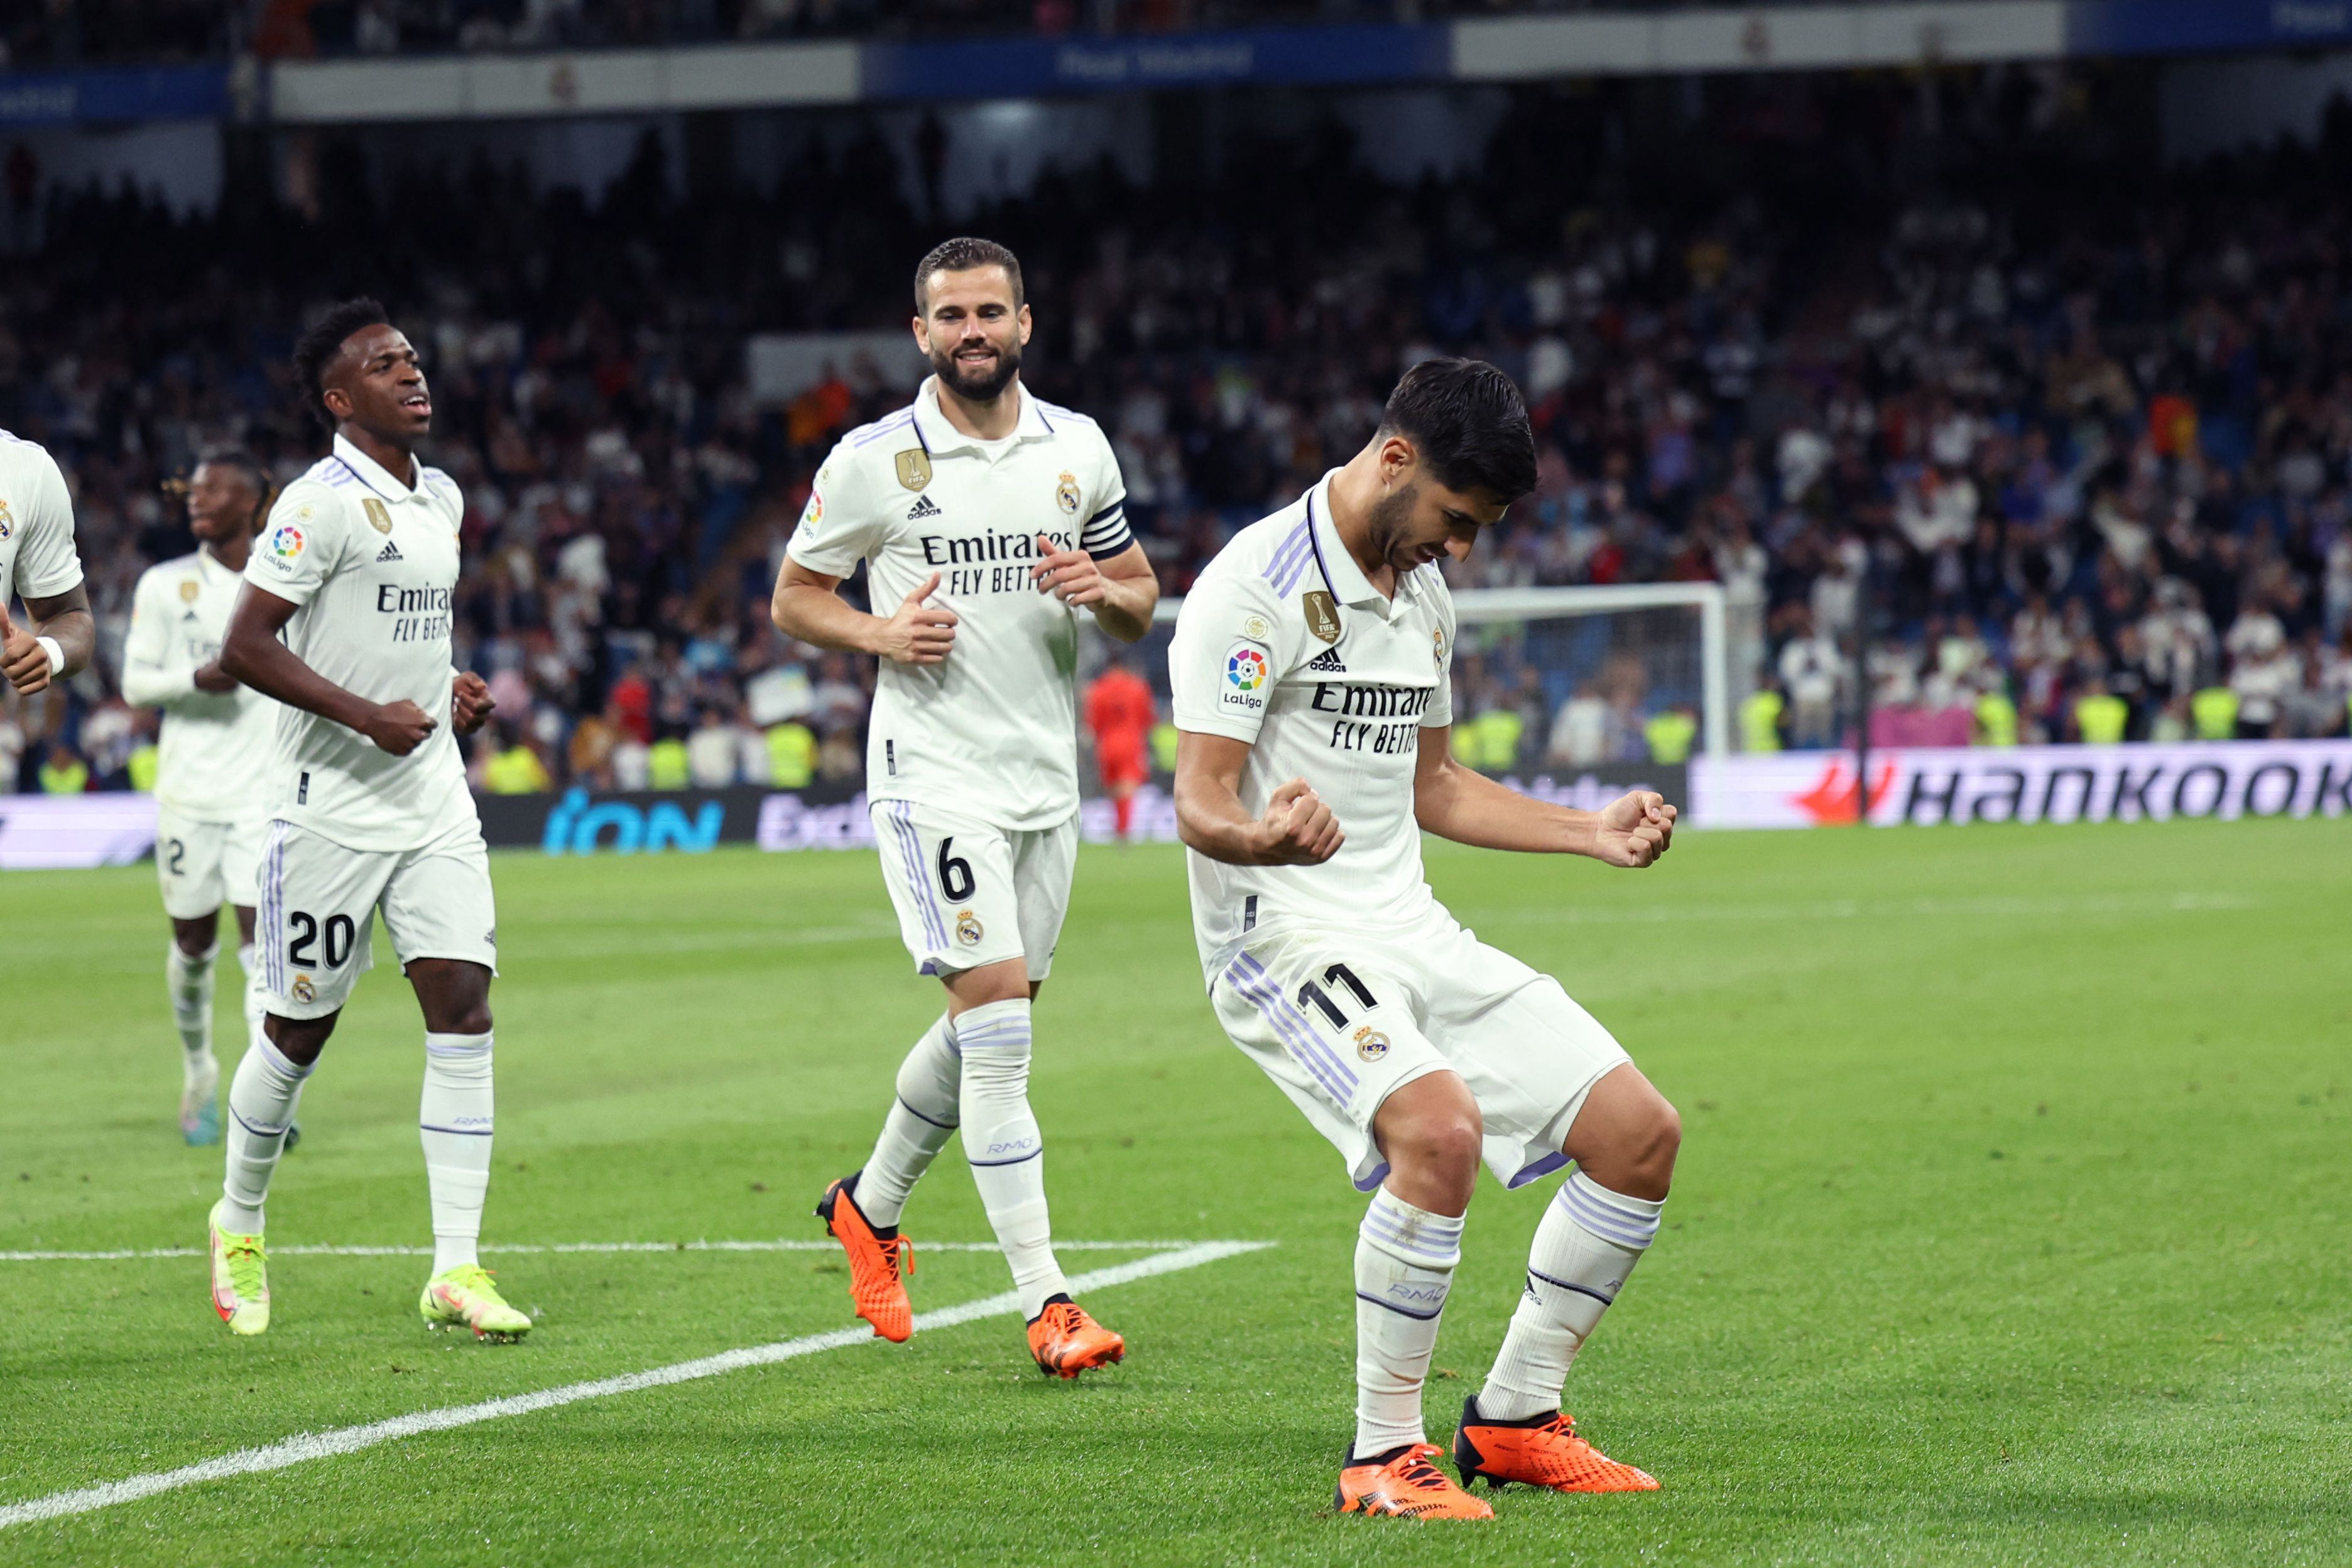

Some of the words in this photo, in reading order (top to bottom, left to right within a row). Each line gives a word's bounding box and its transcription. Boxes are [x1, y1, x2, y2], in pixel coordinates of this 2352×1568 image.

[908, 508, 941, 520] adidas
[264, 552, 292, 573] LaLiga
[950, 569, 983, 596] FLY
[992, 565, 1056, 593] BETT
[393, 618, 419, 642] FLY
[1310, 660, 1346, 673] adidas
[1224, 693, 1262, 709] LaLiga
[1330, 720, 1372, 751] FLY
[936, 836, 976, 905] 6
[288, 911, 355, 971] 20
[1297, 962, 1380, 1034] 11
